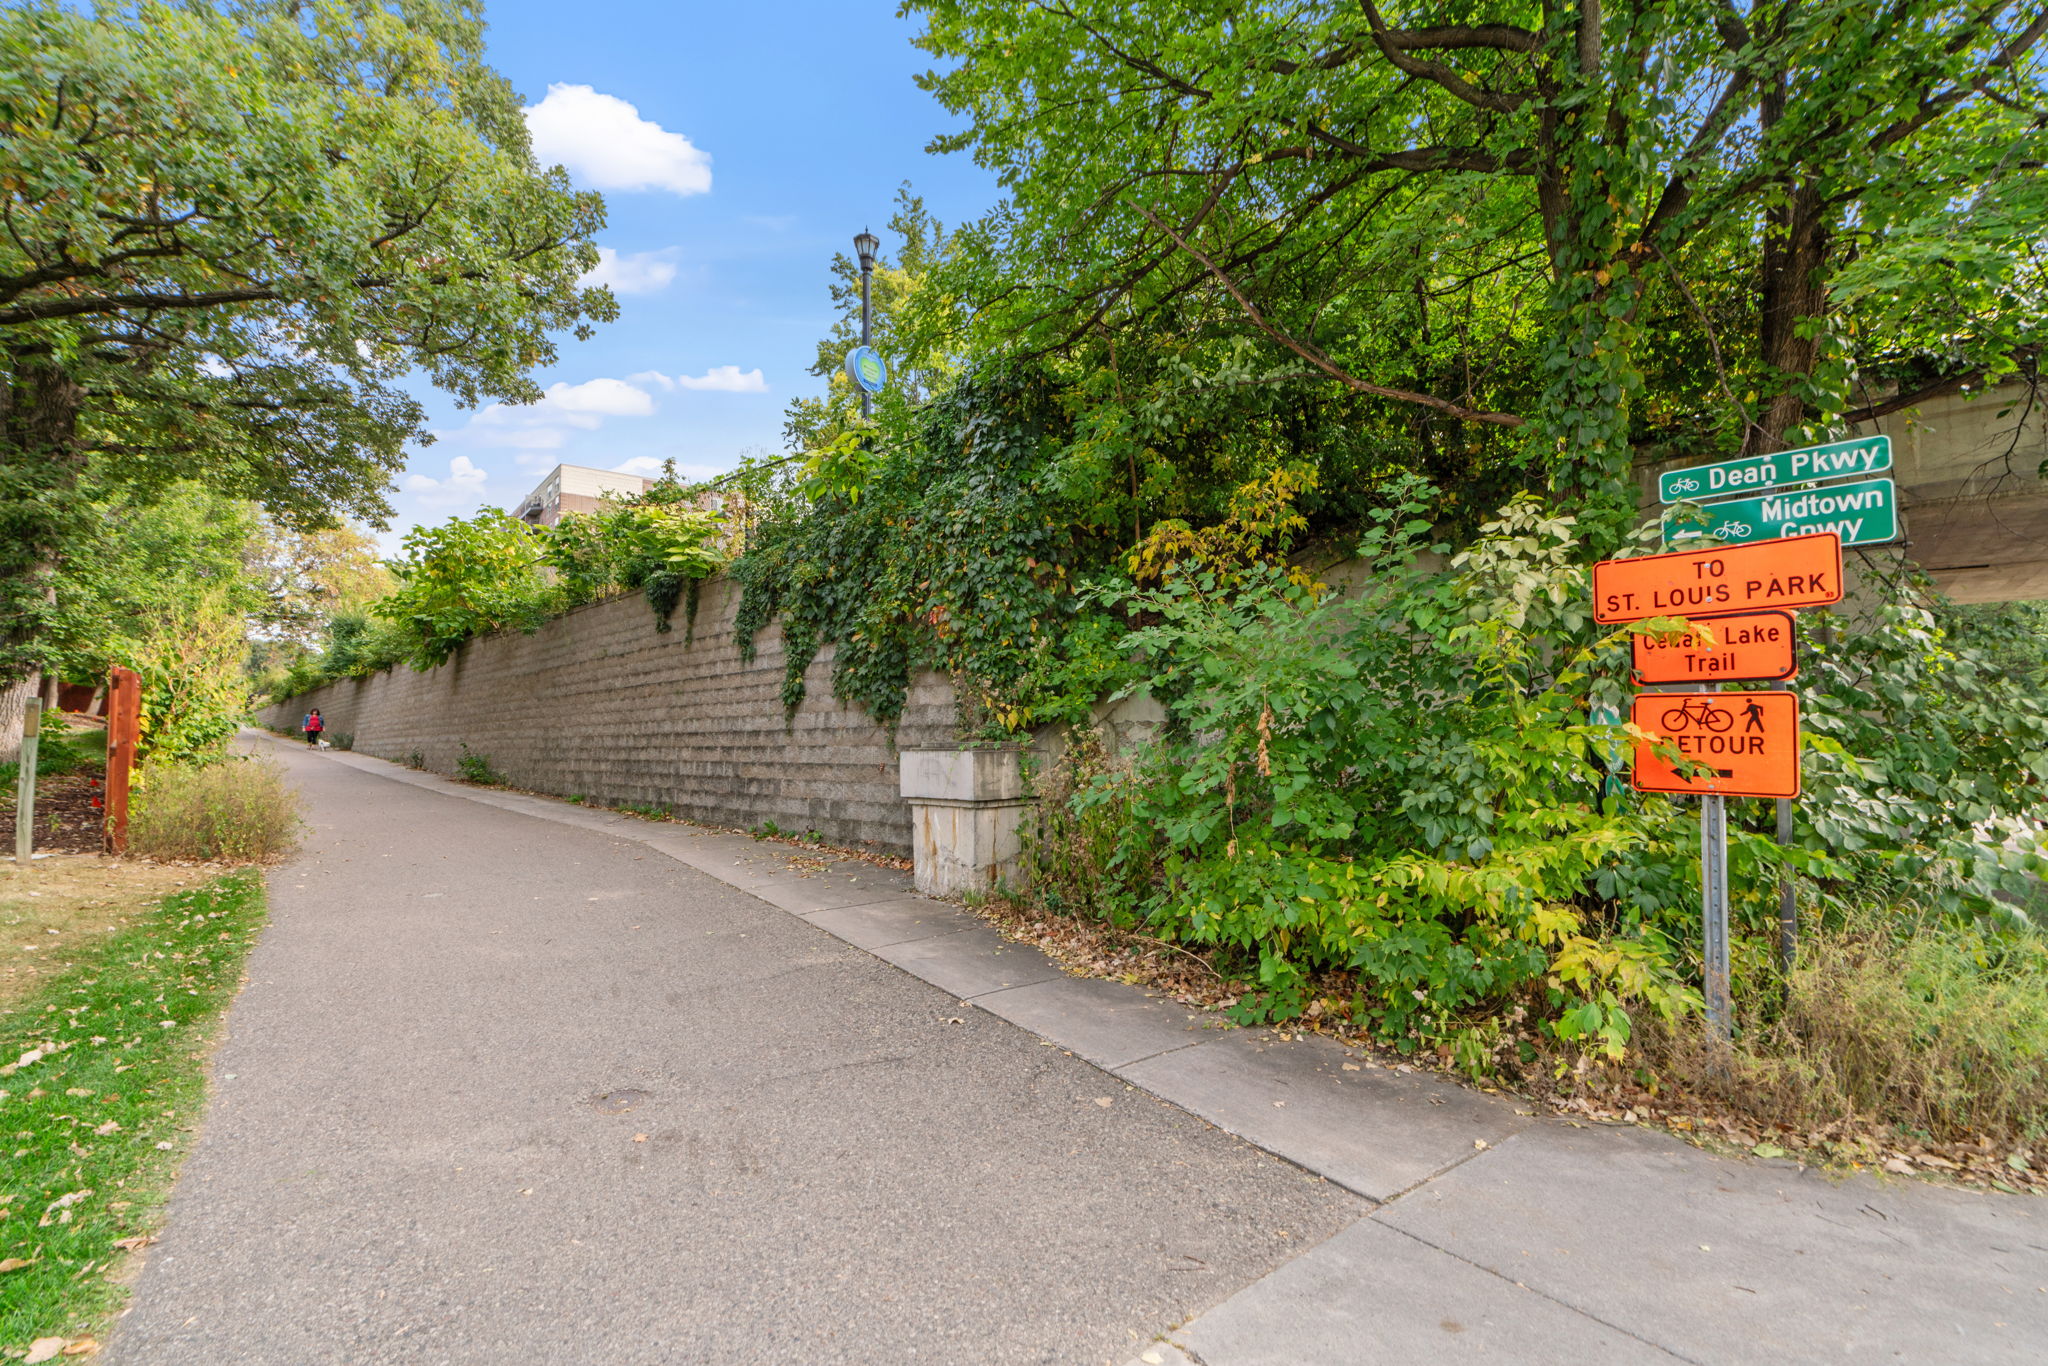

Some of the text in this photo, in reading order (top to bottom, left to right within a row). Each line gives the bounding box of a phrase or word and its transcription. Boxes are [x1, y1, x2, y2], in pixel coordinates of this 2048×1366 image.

[1709, 445, 1879, 489] Dean Pkwy
[1761, 489, 1884, 523] Midtown
[1692, 559, 1725, 579] TO
[1606, 572, 1826, 612] ST. LOUIS PARK
[1725, 624, 1779, 645] Lake
[1685, 652, 1735, 672] Trail
